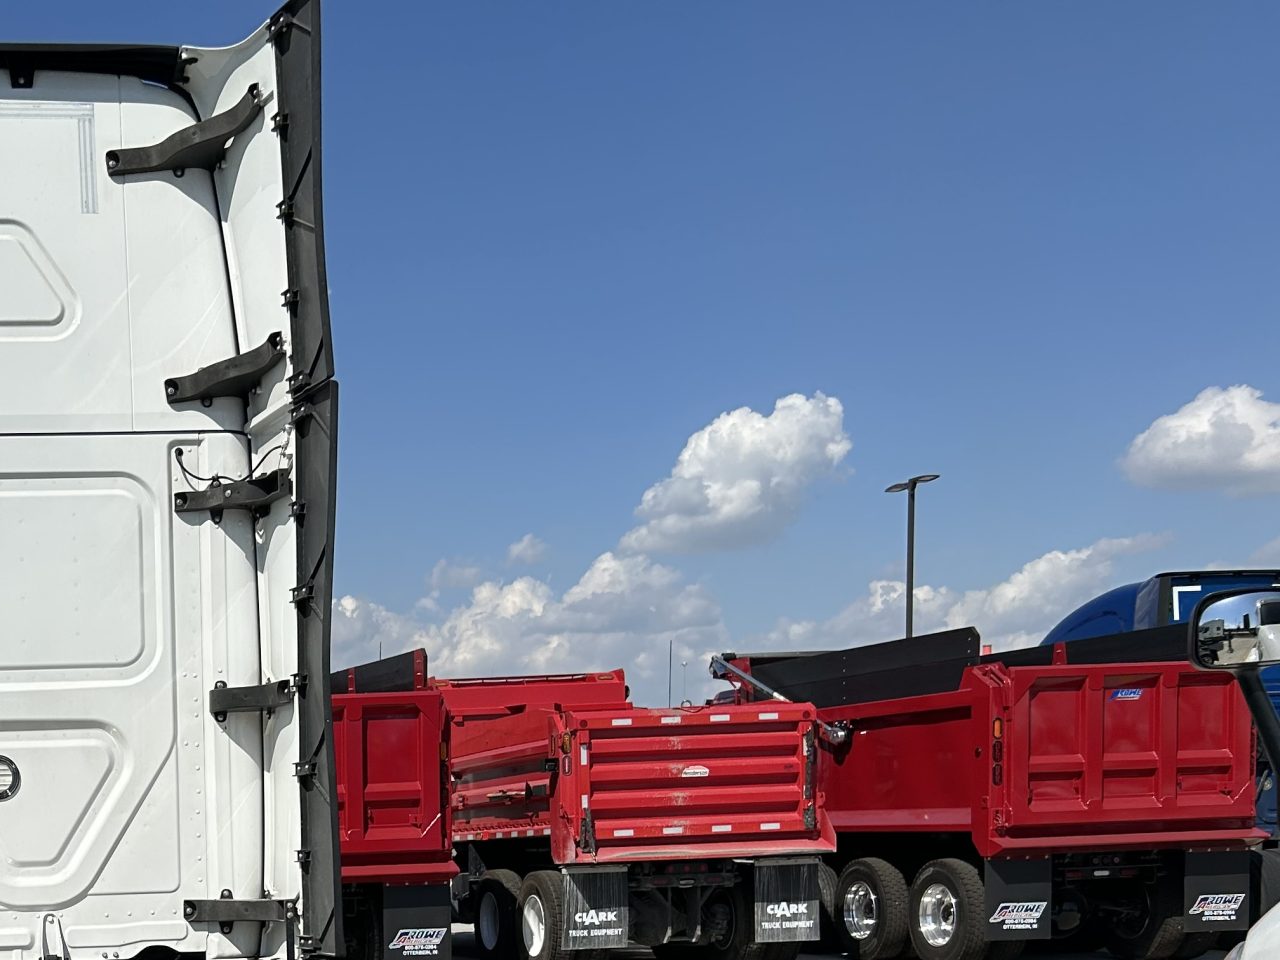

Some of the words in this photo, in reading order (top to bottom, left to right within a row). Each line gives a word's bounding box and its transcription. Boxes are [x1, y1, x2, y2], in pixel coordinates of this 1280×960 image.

[1207, 895, 1243, 904] ROWE
[766, 901, 808, 918] CLARK
[1008, 903, 1045, 913] ROWE
[574, 909, 618, 926] CLARK
[761, 921, 781, 929] TRUCK
[782, 920, 814, 929] EQUIPMENT
[408, 930, 445, 939] ROWE
[568, 929, 589, 937] TRUCK
[590, 928, 623, 937] EQUIPMENT
